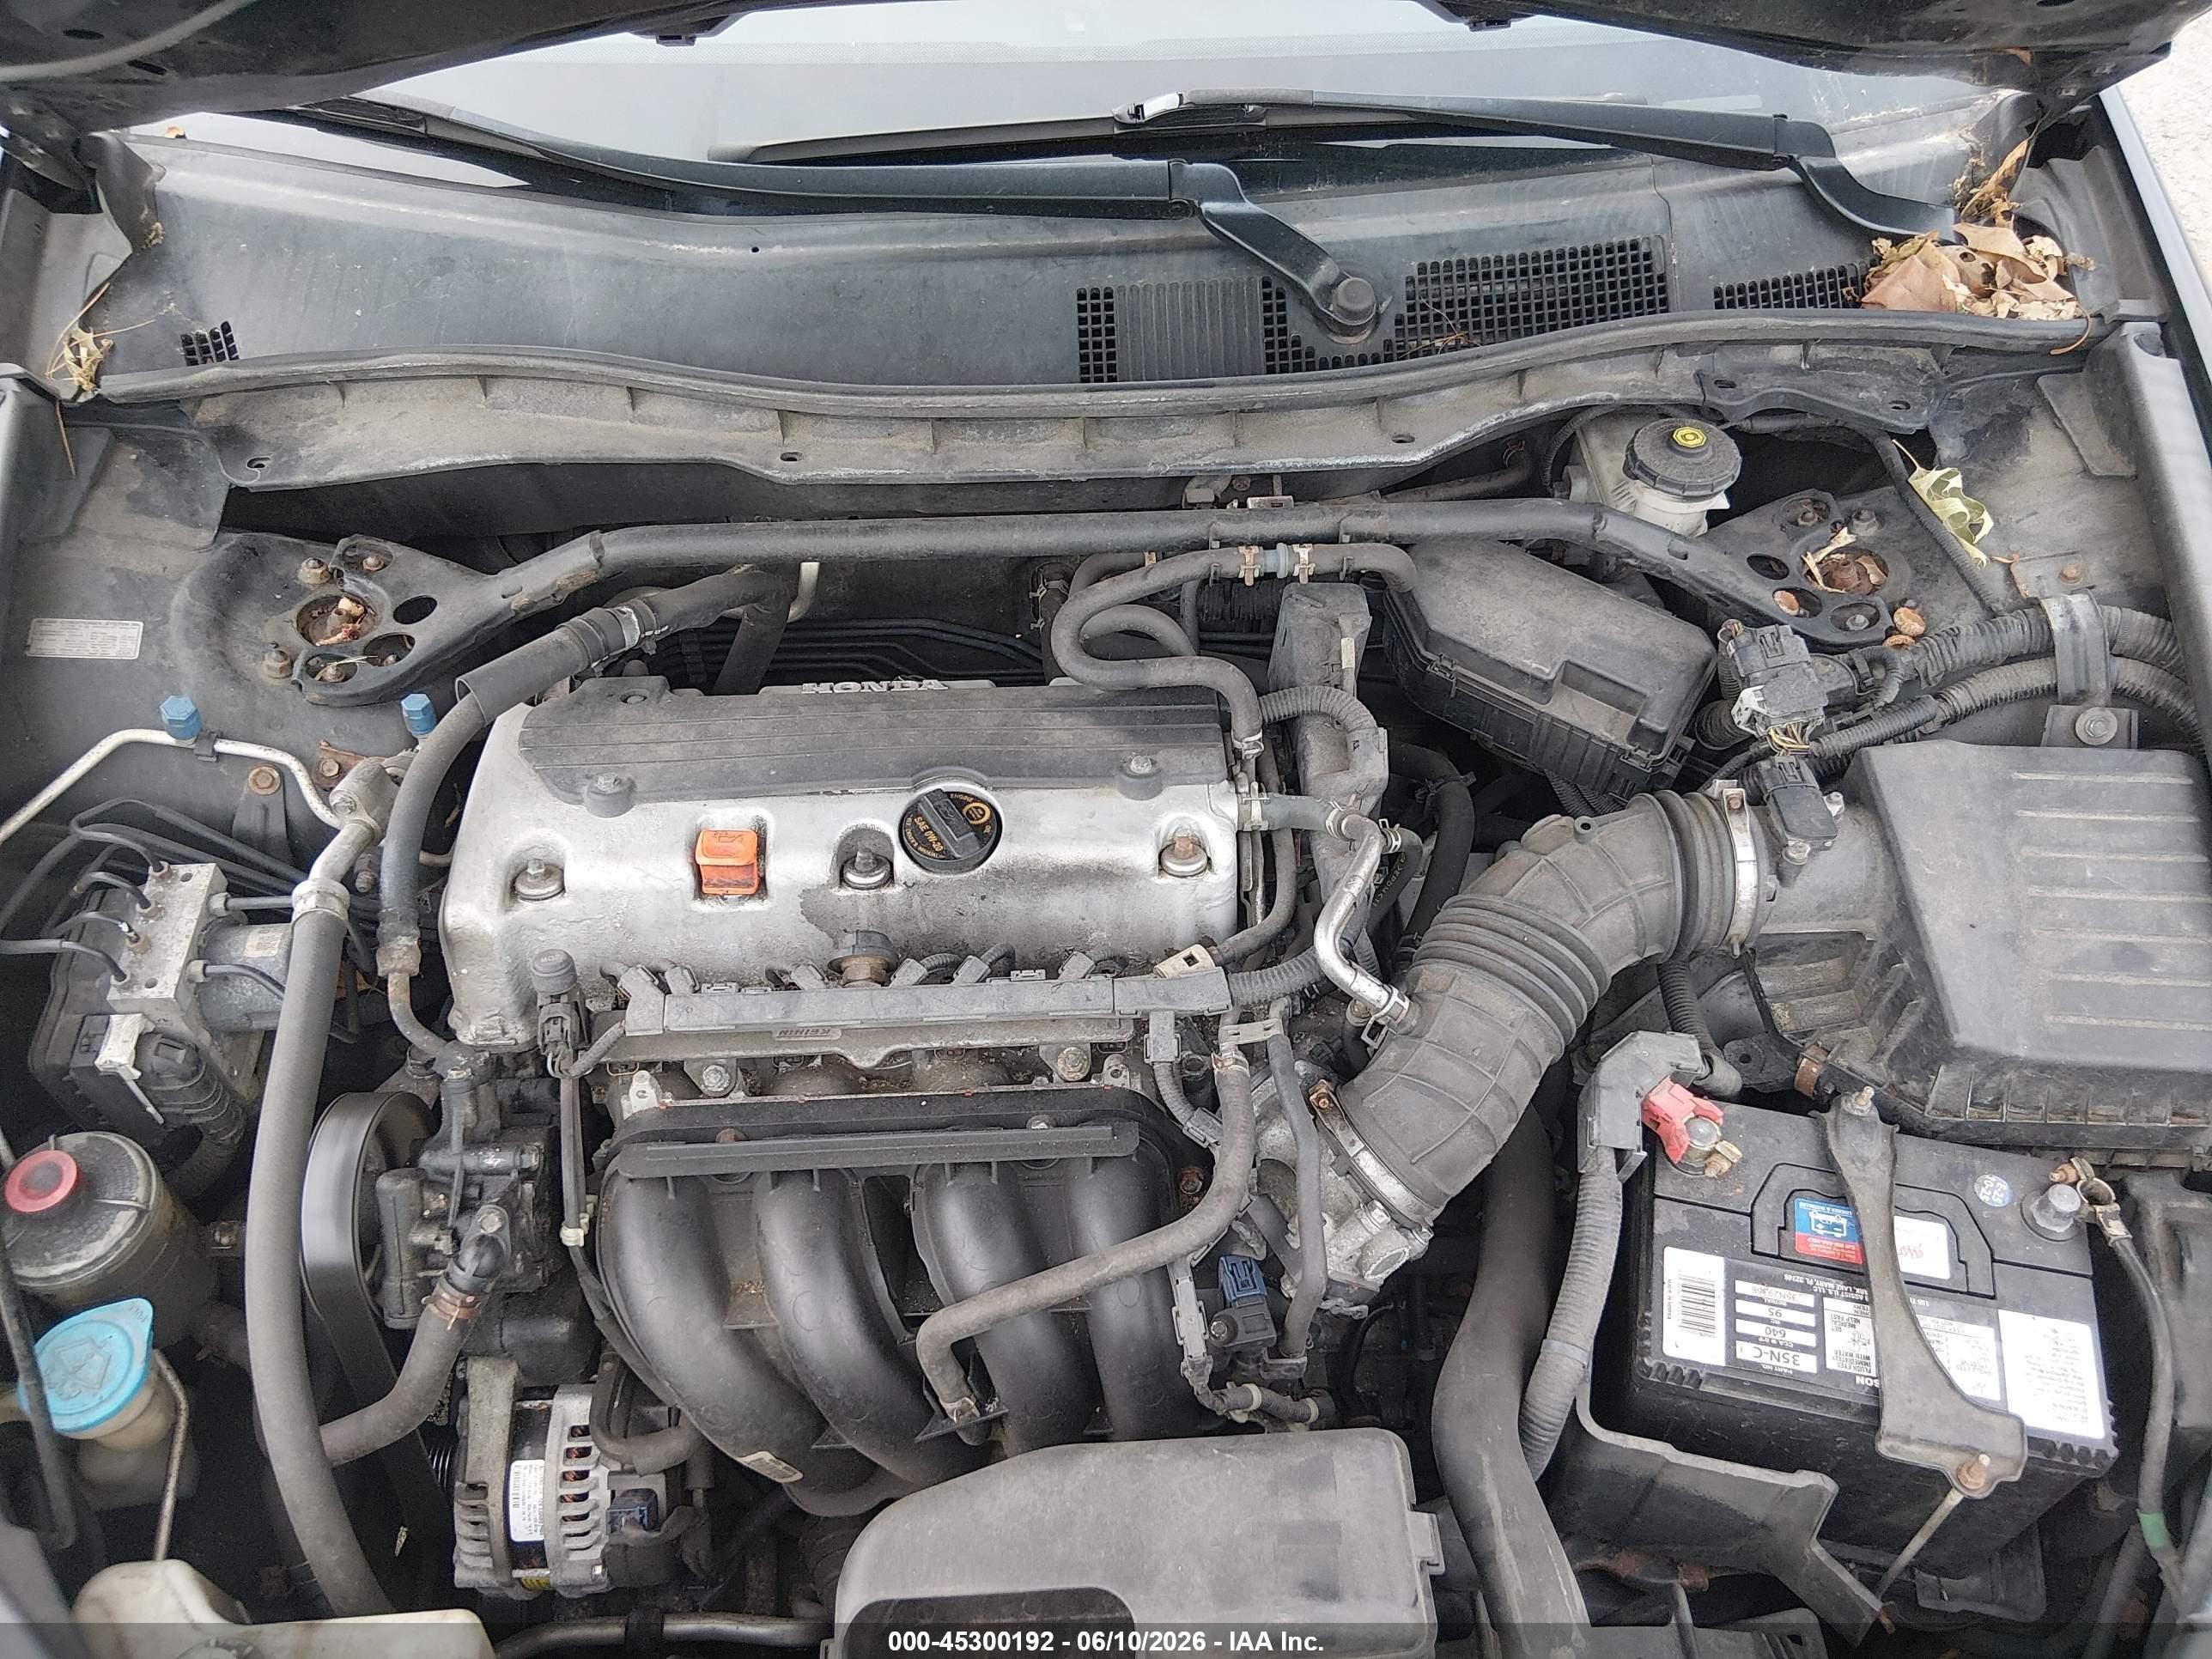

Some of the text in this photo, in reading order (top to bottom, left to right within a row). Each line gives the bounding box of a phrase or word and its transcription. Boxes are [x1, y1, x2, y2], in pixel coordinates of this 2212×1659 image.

[801, 679, 949, 694] HONDA
[950, 793, 975, 803] ENGINE
[914, 816, 945, 853] SAE 0W-20
[1813, 1285, 1826, 1294] LLC
[1768, 1308, 1783, 1318] 95
[1765, 1326, 1787, 1339] 640
[1753, 1346, 1801, 1366] 35N-C
[1773, 1366, 1793, 1375] PART
[1855, 1375, 1881, 1388] SON
